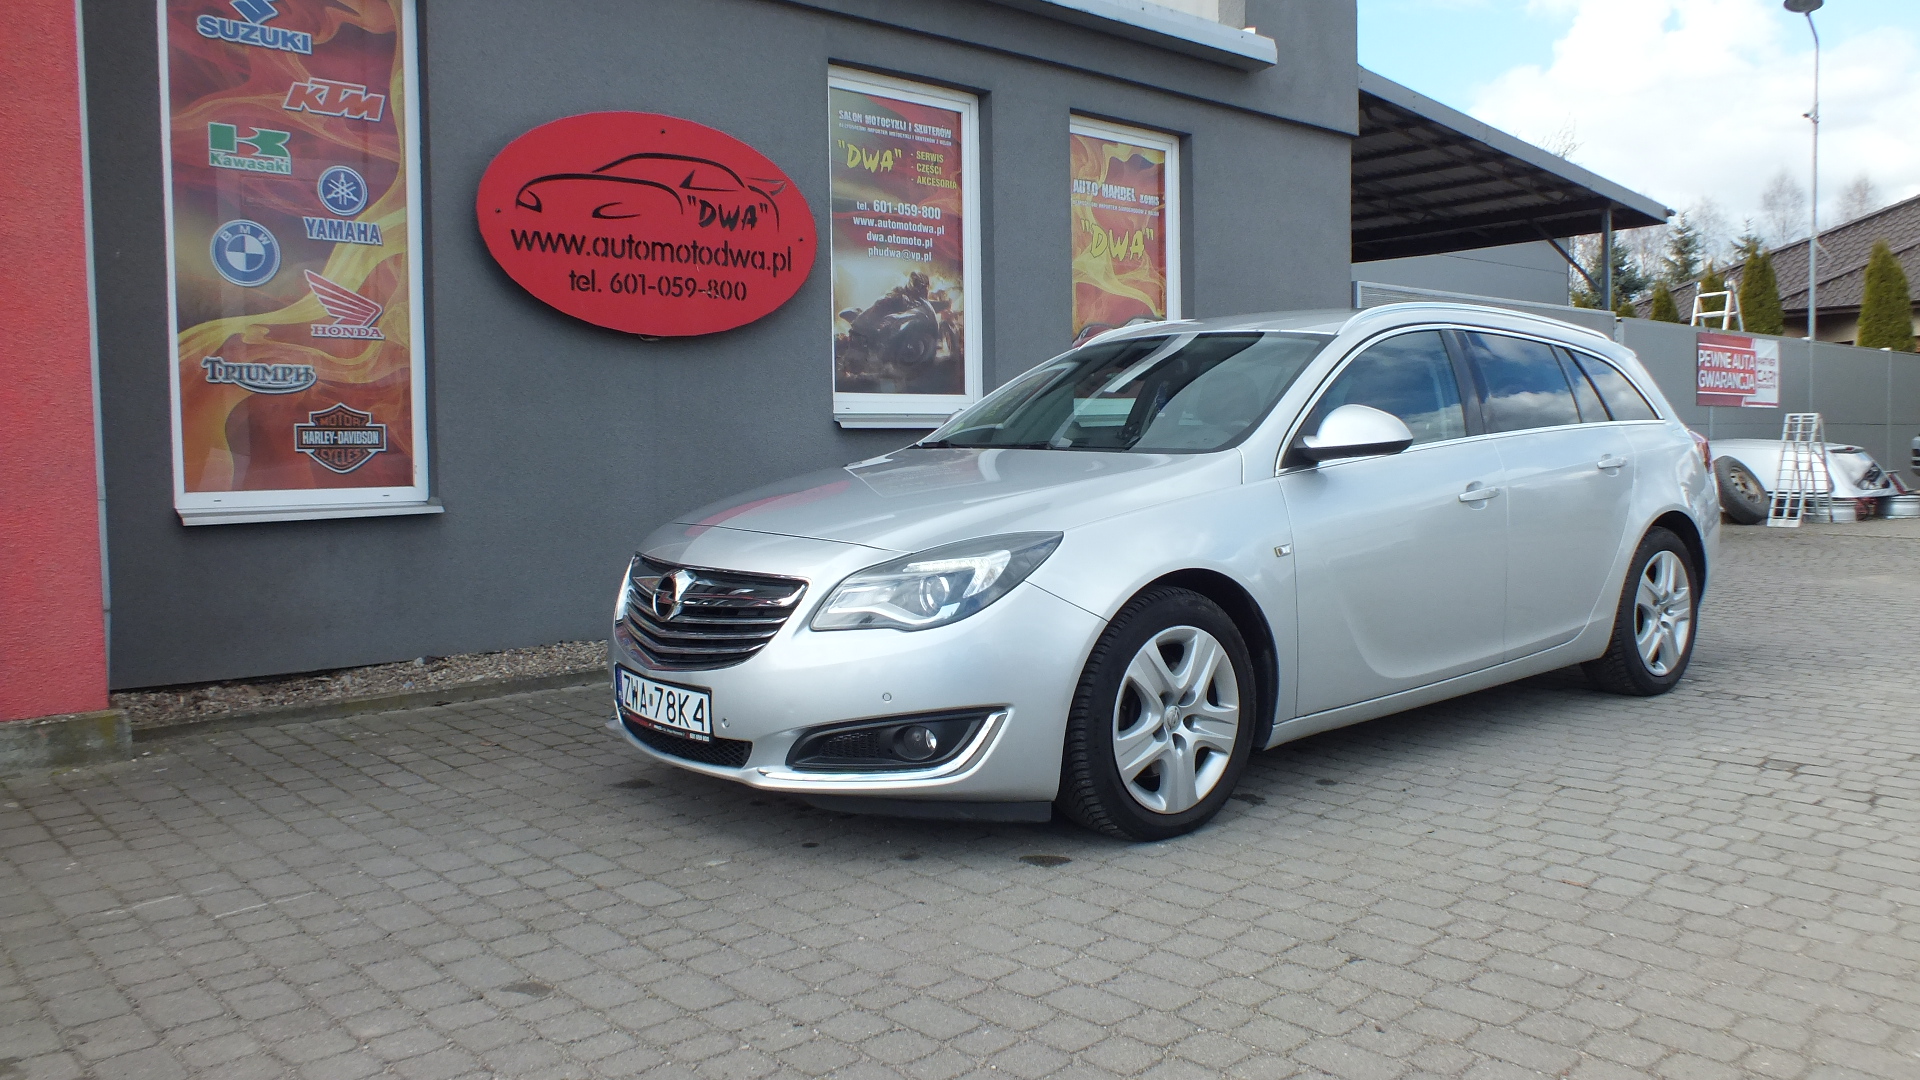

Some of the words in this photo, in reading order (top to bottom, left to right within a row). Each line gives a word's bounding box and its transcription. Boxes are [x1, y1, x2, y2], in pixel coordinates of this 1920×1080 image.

[197, 15, 312, 54] SUZUKI
[283, 77, 385, 121] KTM
[838, 110, 863, 123] SALON
[865, 114, 907, 130] MOTOCYKLI
[908, 122, 912, 133] I
[914, 124, 952, 138] SKUTERÓW
[209, 151, 292, 174] Kawasaki
[838, 139, 902, 173] "DWA"
[916, 151, 944, 163] SERWIS
[916, 163, 942, 175] CZĘŚCI
[916, 176, 957, 190] AKCESORIA
[1073, 179, 1099, 197] AUTO
[1101, 184, 1136, 202] HANDEL
[687, 195, 768, 232] "DWA"
[856, 201, 870, 211] tel.
[873, 199, 941, 220] 601-059-800
[219, 224, 271, 245] BMW
[303, 216, 383, 245] YAMAHA
[853, 216, 945, 235] www.automotodwa.pl
[866, 231, 933, 248] dwa.otomoto.pl
[1081, 218, 1154, 261] "DWA"
[511, 229, 792, 277] www.automotodwa.pl
[868, 246, 932, 262] phudwa@vp.pl
[569, 269, 602, 293] tel.
[610, 272, 747, 301] 601-059-800
[311, 324, 385, 339] HONDA
[1697, 349, 1732, 368] PEWNE
[1732, 354, 1755, 370] AUTA
[202, 357, 316, 386] TRIUMPH
[1697, 370, 1755, 390] GWARANCJA
[318, 415, 362, 427] MOTOR
[302, 431, 379, 445] HARLEY-DAVIDSON
[320, 449, 361, 465] CYCLES
[654, 686, 705, 732] 78K4
